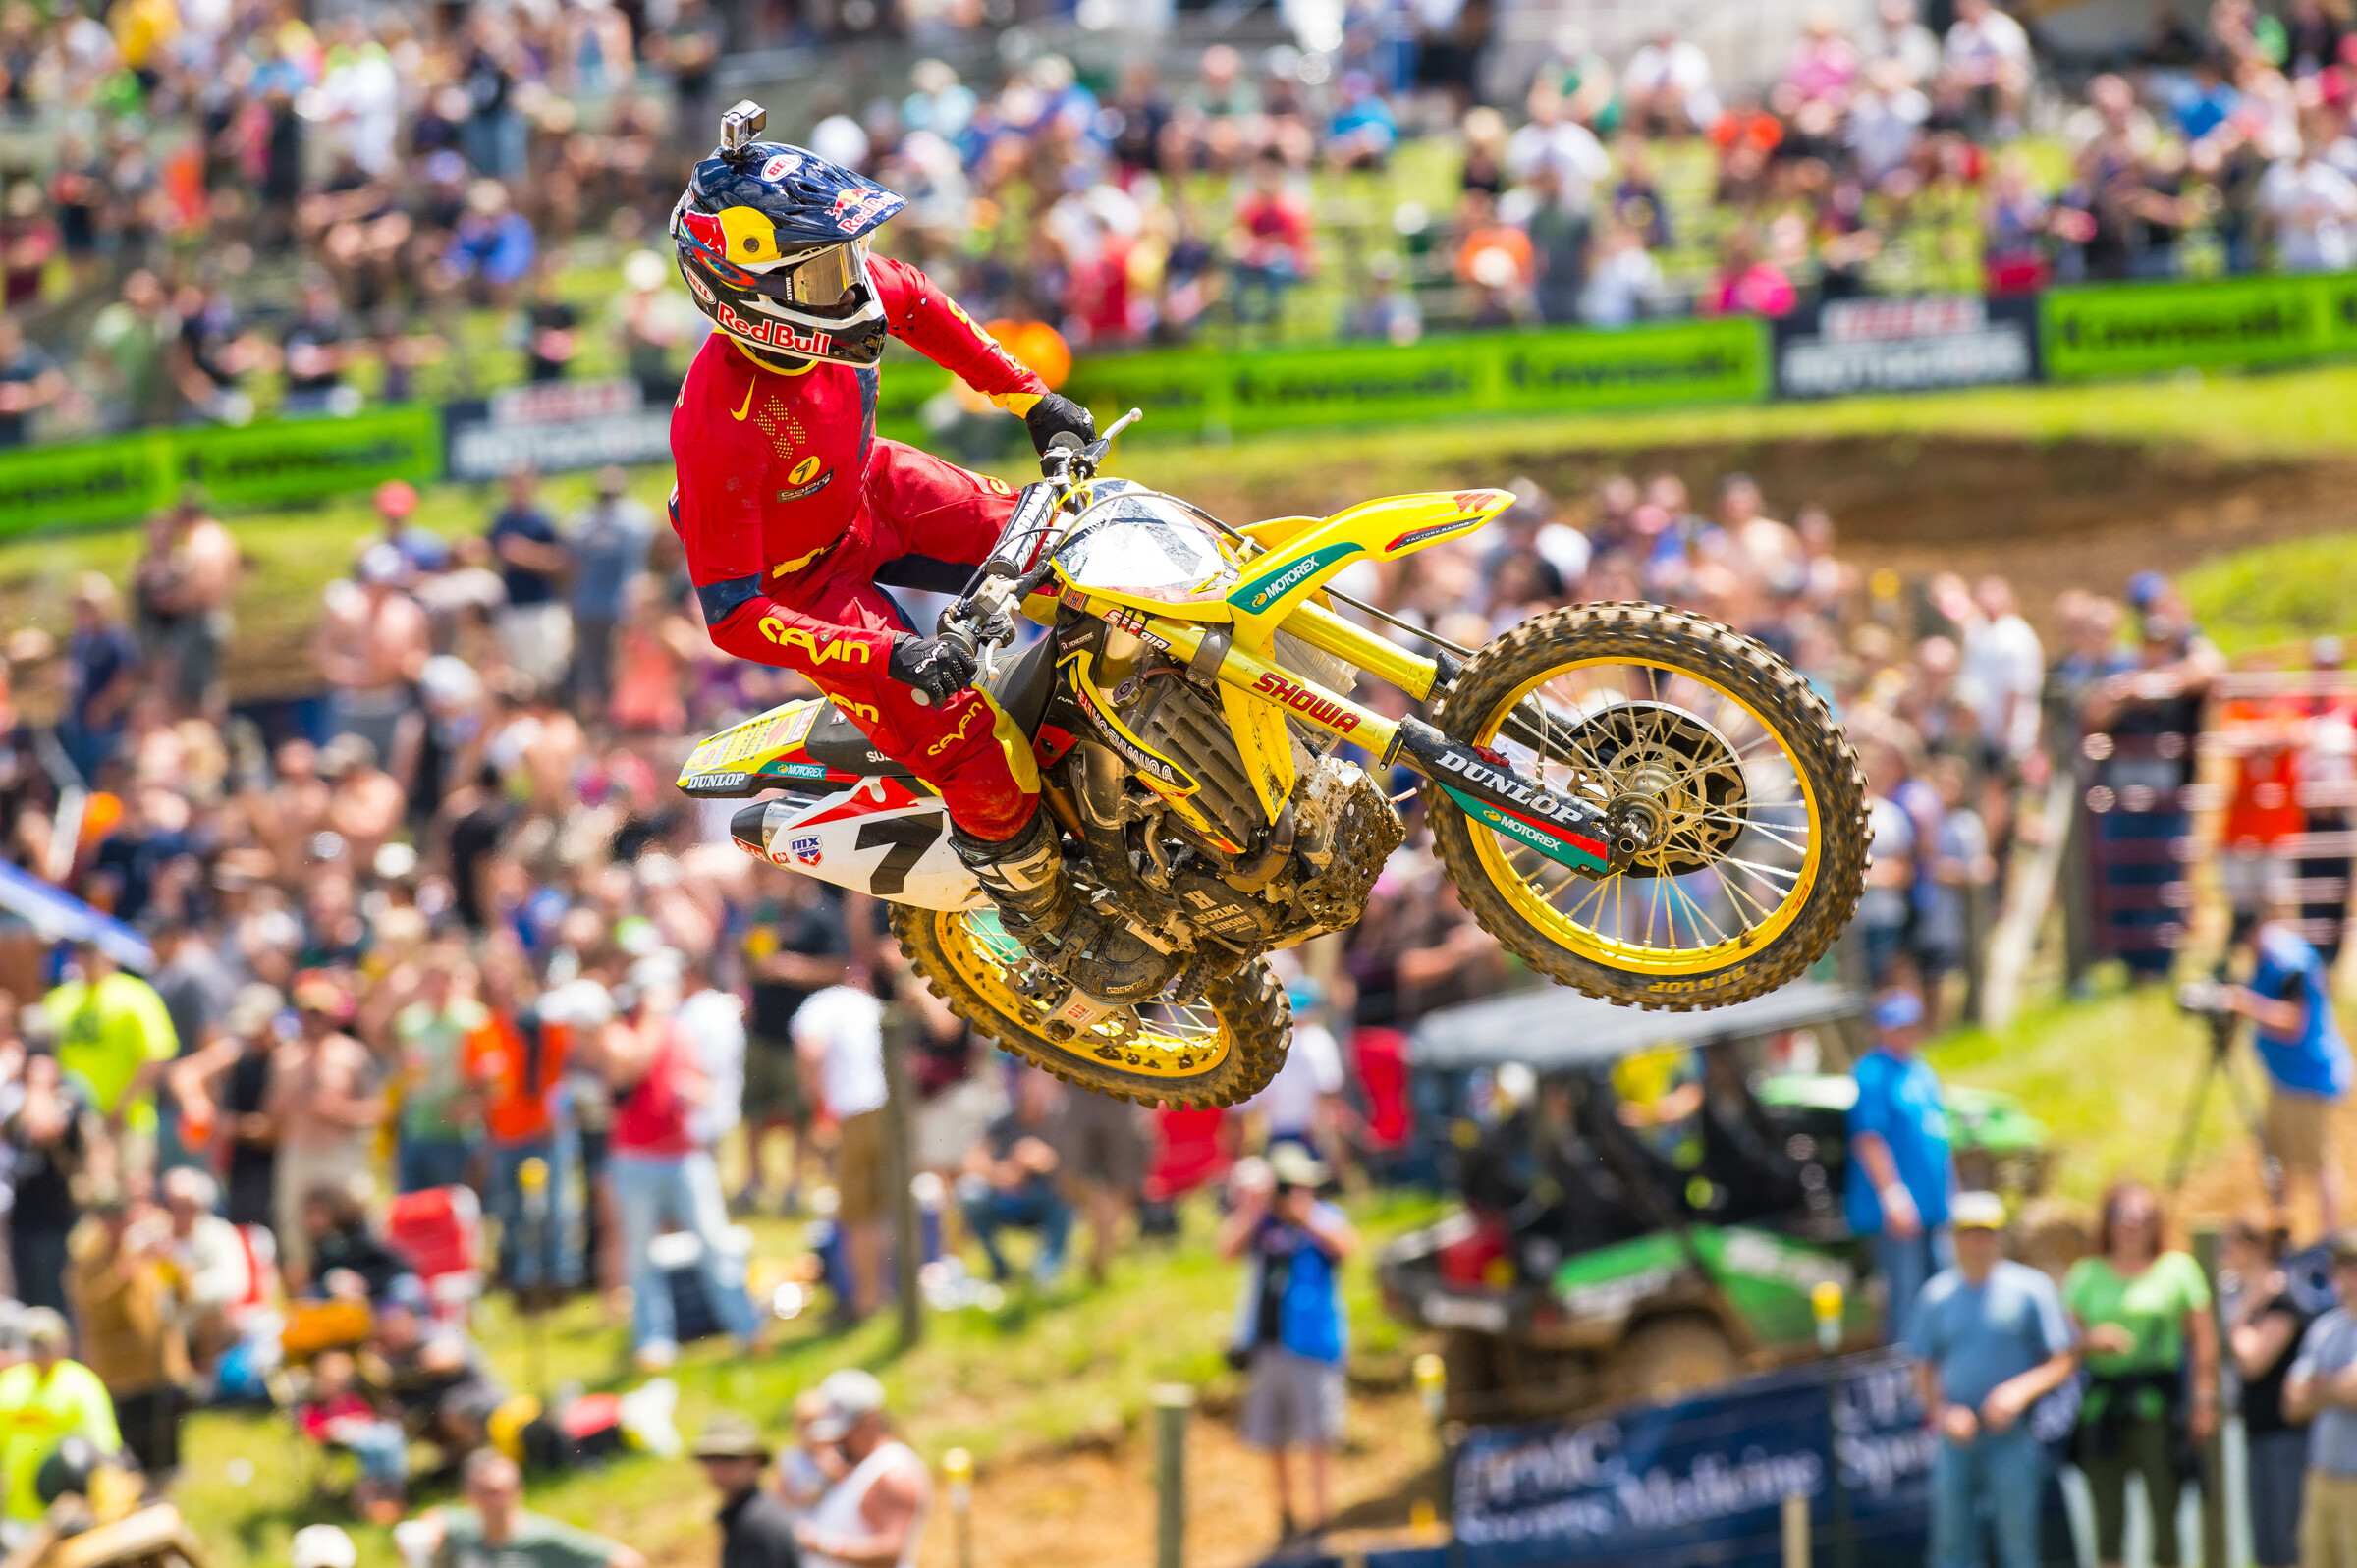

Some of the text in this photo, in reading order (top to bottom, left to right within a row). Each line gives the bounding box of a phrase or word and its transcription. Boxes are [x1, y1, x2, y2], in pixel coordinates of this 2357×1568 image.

[767, 156, 796, 177] BELL
[839, 203, 877, 233] Red
[687, 270, 709, 300] BELL
[718, 302, 831, 355] Red Bull
[781, 473, 832, 497] GoPro
[795, 458, 813, 484] 7
[1405, 521, 1470, 543] FACTORY RACING
[1264, 555, 1320, 599] MOTOREX
[1252, 672, 1362, 733] SHOWA
[687, 772, 746, 789] DUNLOP
[787, 764, 824, 778] MOTOREX
[1435, 750, 1583, 823] DUNLOP
[1501, 816, 1562, 851] MOTOREX
[854, 811, 944, 894] 7
[1192, 903, 1245, 925] SUZUKI
[1647, 965, 1748, 994] DUNLOP
